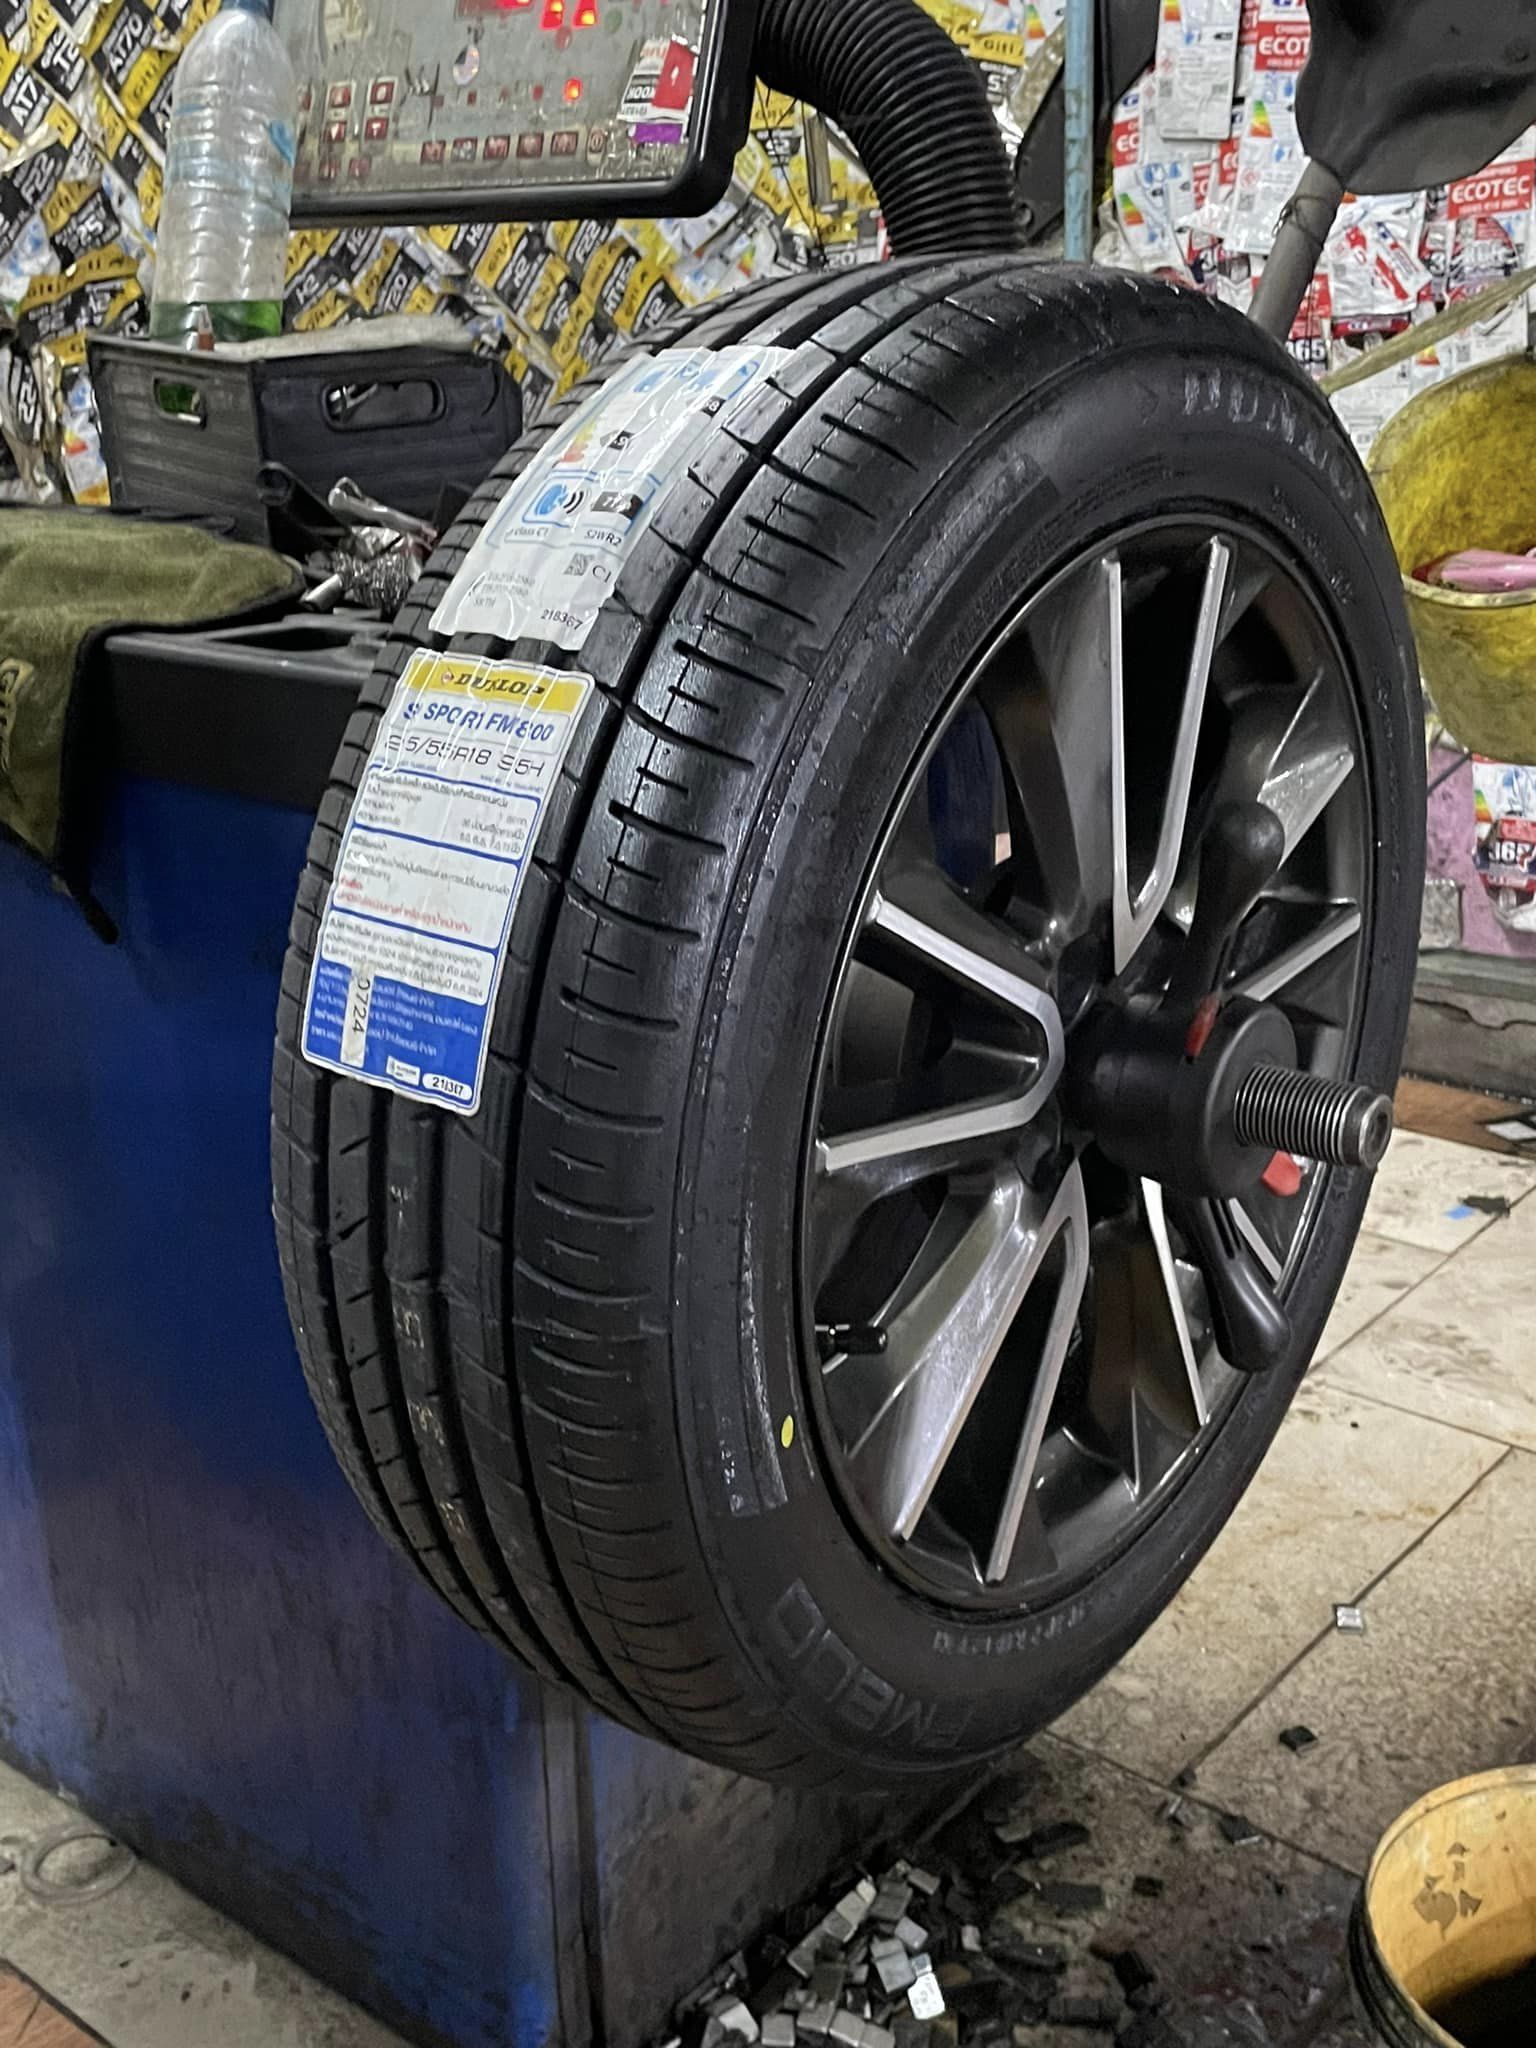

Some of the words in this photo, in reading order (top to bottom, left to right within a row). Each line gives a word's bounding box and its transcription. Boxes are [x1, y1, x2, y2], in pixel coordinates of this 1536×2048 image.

[109, 13, 143, 74] AT70
[1451, 174, 1530, 204] ECOTEC
[454, 671, 545, 697] DUNLOP
